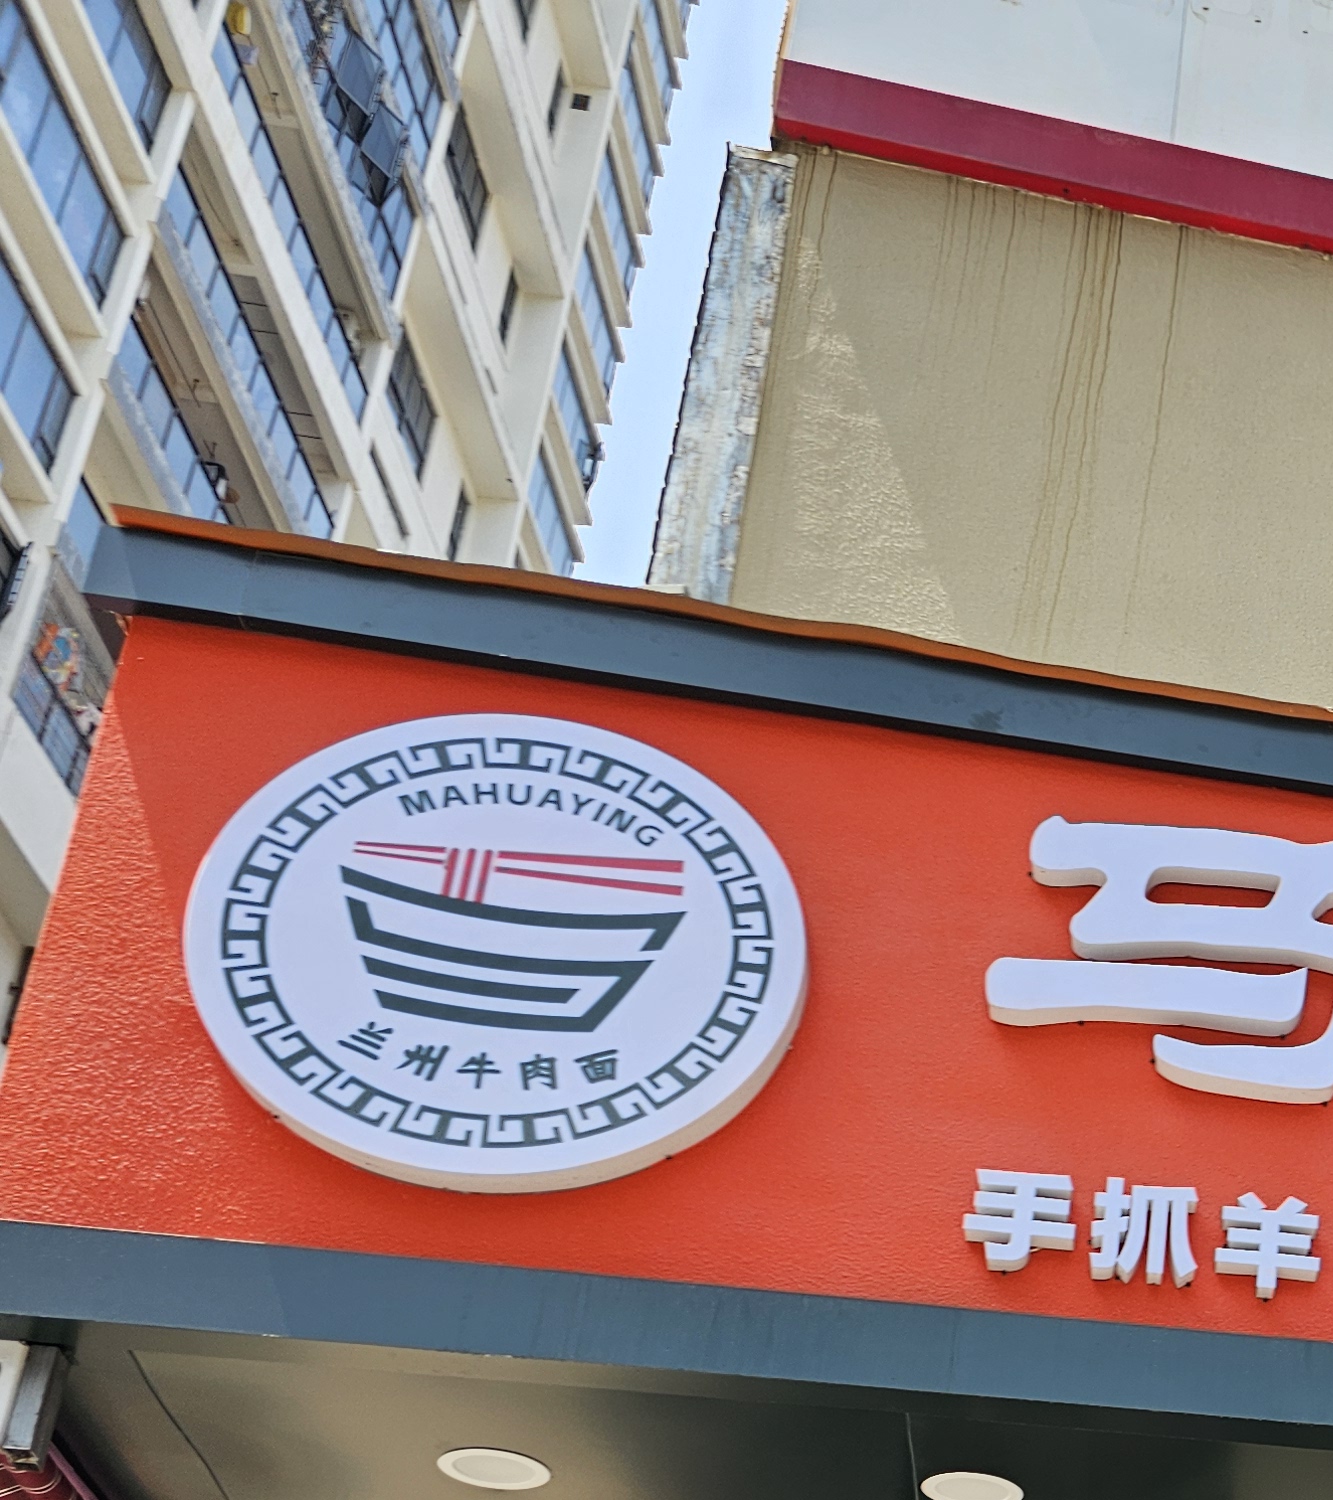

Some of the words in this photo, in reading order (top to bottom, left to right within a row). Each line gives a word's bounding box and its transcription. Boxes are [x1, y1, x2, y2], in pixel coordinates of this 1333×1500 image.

[397, 780, 663, 848] MAHUAYING
[338, 1021, 620, 1090] 兰州牛肉面
